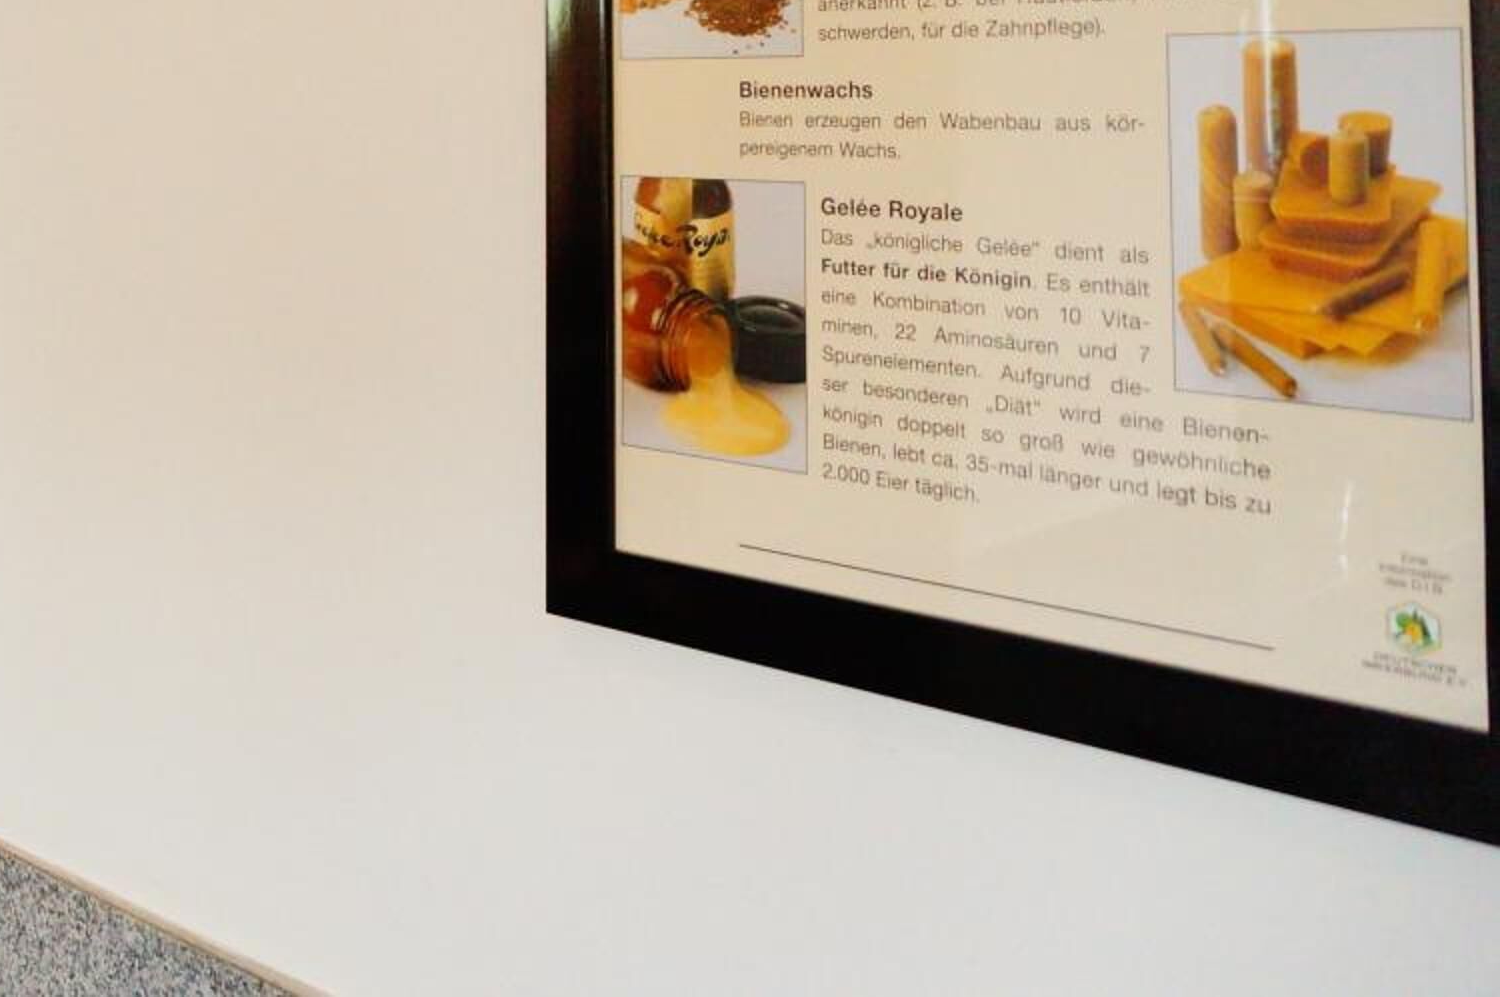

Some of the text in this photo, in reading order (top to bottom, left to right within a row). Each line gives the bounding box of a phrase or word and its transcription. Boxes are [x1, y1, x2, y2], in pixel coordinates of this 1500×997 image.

[817, 16, 1105, 42] schwerden, für die Zahnpflege).
[739, 80, 874, 100] Bienenwachs
[739, 110, 1145, 133] Bienen erzeugen den Wabenbau aus kör-
[739, 139, 901, 161] pereigenem Wachs.
[820, 196, 963, 224] Gelée Royale
[821, 227, 854, 247] Das
[1054, 242, 1105, 262] dient
[1119, 245, 1150, 265] als
[821, 257, 1151, 298] Futter für die Königin. Es enthält
[820, 287, 1150, 331] eine Kombination von 10 Vita-
[821, 317, 1150, 364] minen, 22 Aminosäuren und 7
[822, 344, 1150, 397] Spurenelementen. Aufgrund die-
[820, 378, 849, 393] ser
[862, 378, 969, 408] besonderen
[1059, 406, 1102, 425] wird
[1119, 411, 1164, 433] eine
[1182, 416, 1269, 444] Bienen-
[822, 404, 1271, 481] königin doppelt so groß wie gewöhnliche
[822, 432, 1272, 516] Bienen, lebt ca. 35-mal länger und legt bis zu
[822, 461, 979, 502] 2.000 Eier täglich.
